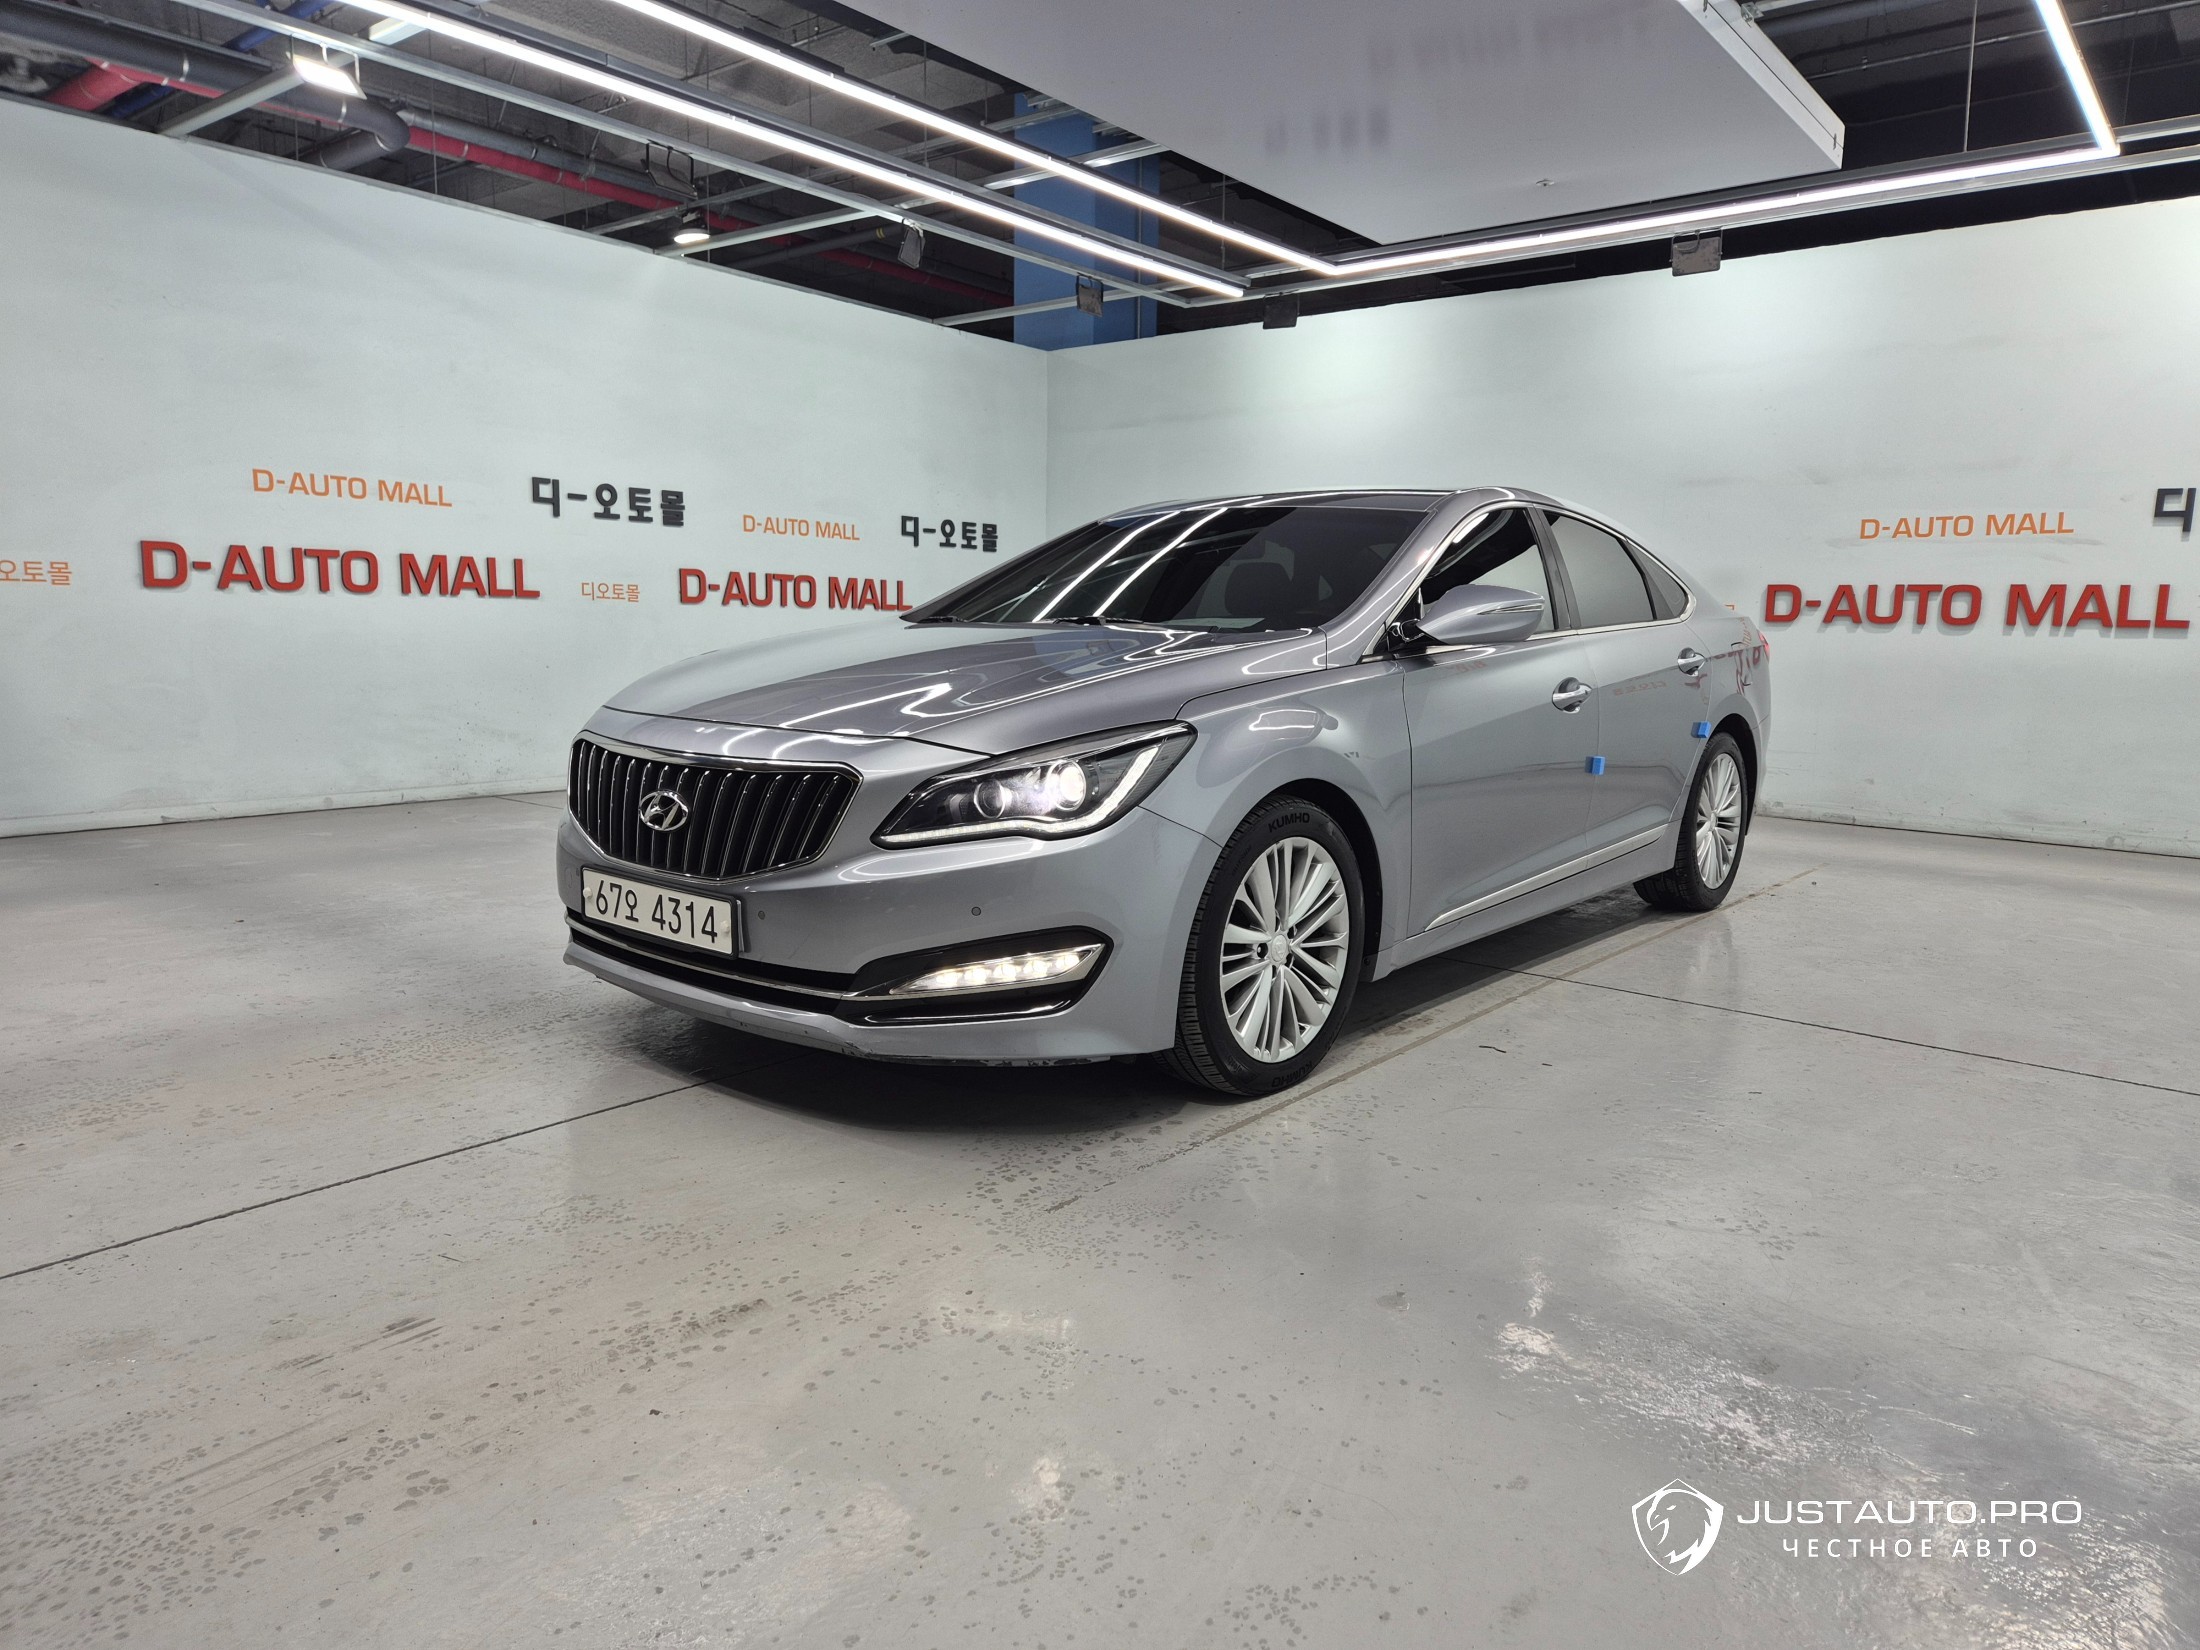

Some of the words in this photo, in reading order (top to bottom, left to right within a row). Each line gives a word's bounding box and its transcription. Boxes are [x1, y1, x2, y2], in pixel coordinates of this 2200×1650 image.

[252, 468, 368, 500] D-AUTO
[378, 480, 452, 508] MALL
[532, 477, 685, 526] 디-오토몰
[743, 514, 810, 538] D-AUTO
[815, 521, 860, 541] MALL
[901, 515, 998, 553] 디-오토몰
[1859, 515, 1975, 540] D-AUTO
[1985, 512, 2075, 537] MALL
[140, 540, 379, 594] D-AUTO
[400, 552, 540, 598] MALL
[581, 582, 640, 603] 디오토몰
[679, 568, 817, 609] D-AUTO
[828, 576, 913, 612] MALL
[1764, 584, 1983, 626] D-AUTO
[2006, 584, 2190, 629] MALL
[1267, 812, 1311, 833] KUMHO
[596, 880, 639, 923] 67오
[651, 894, 718, 944] 4314
